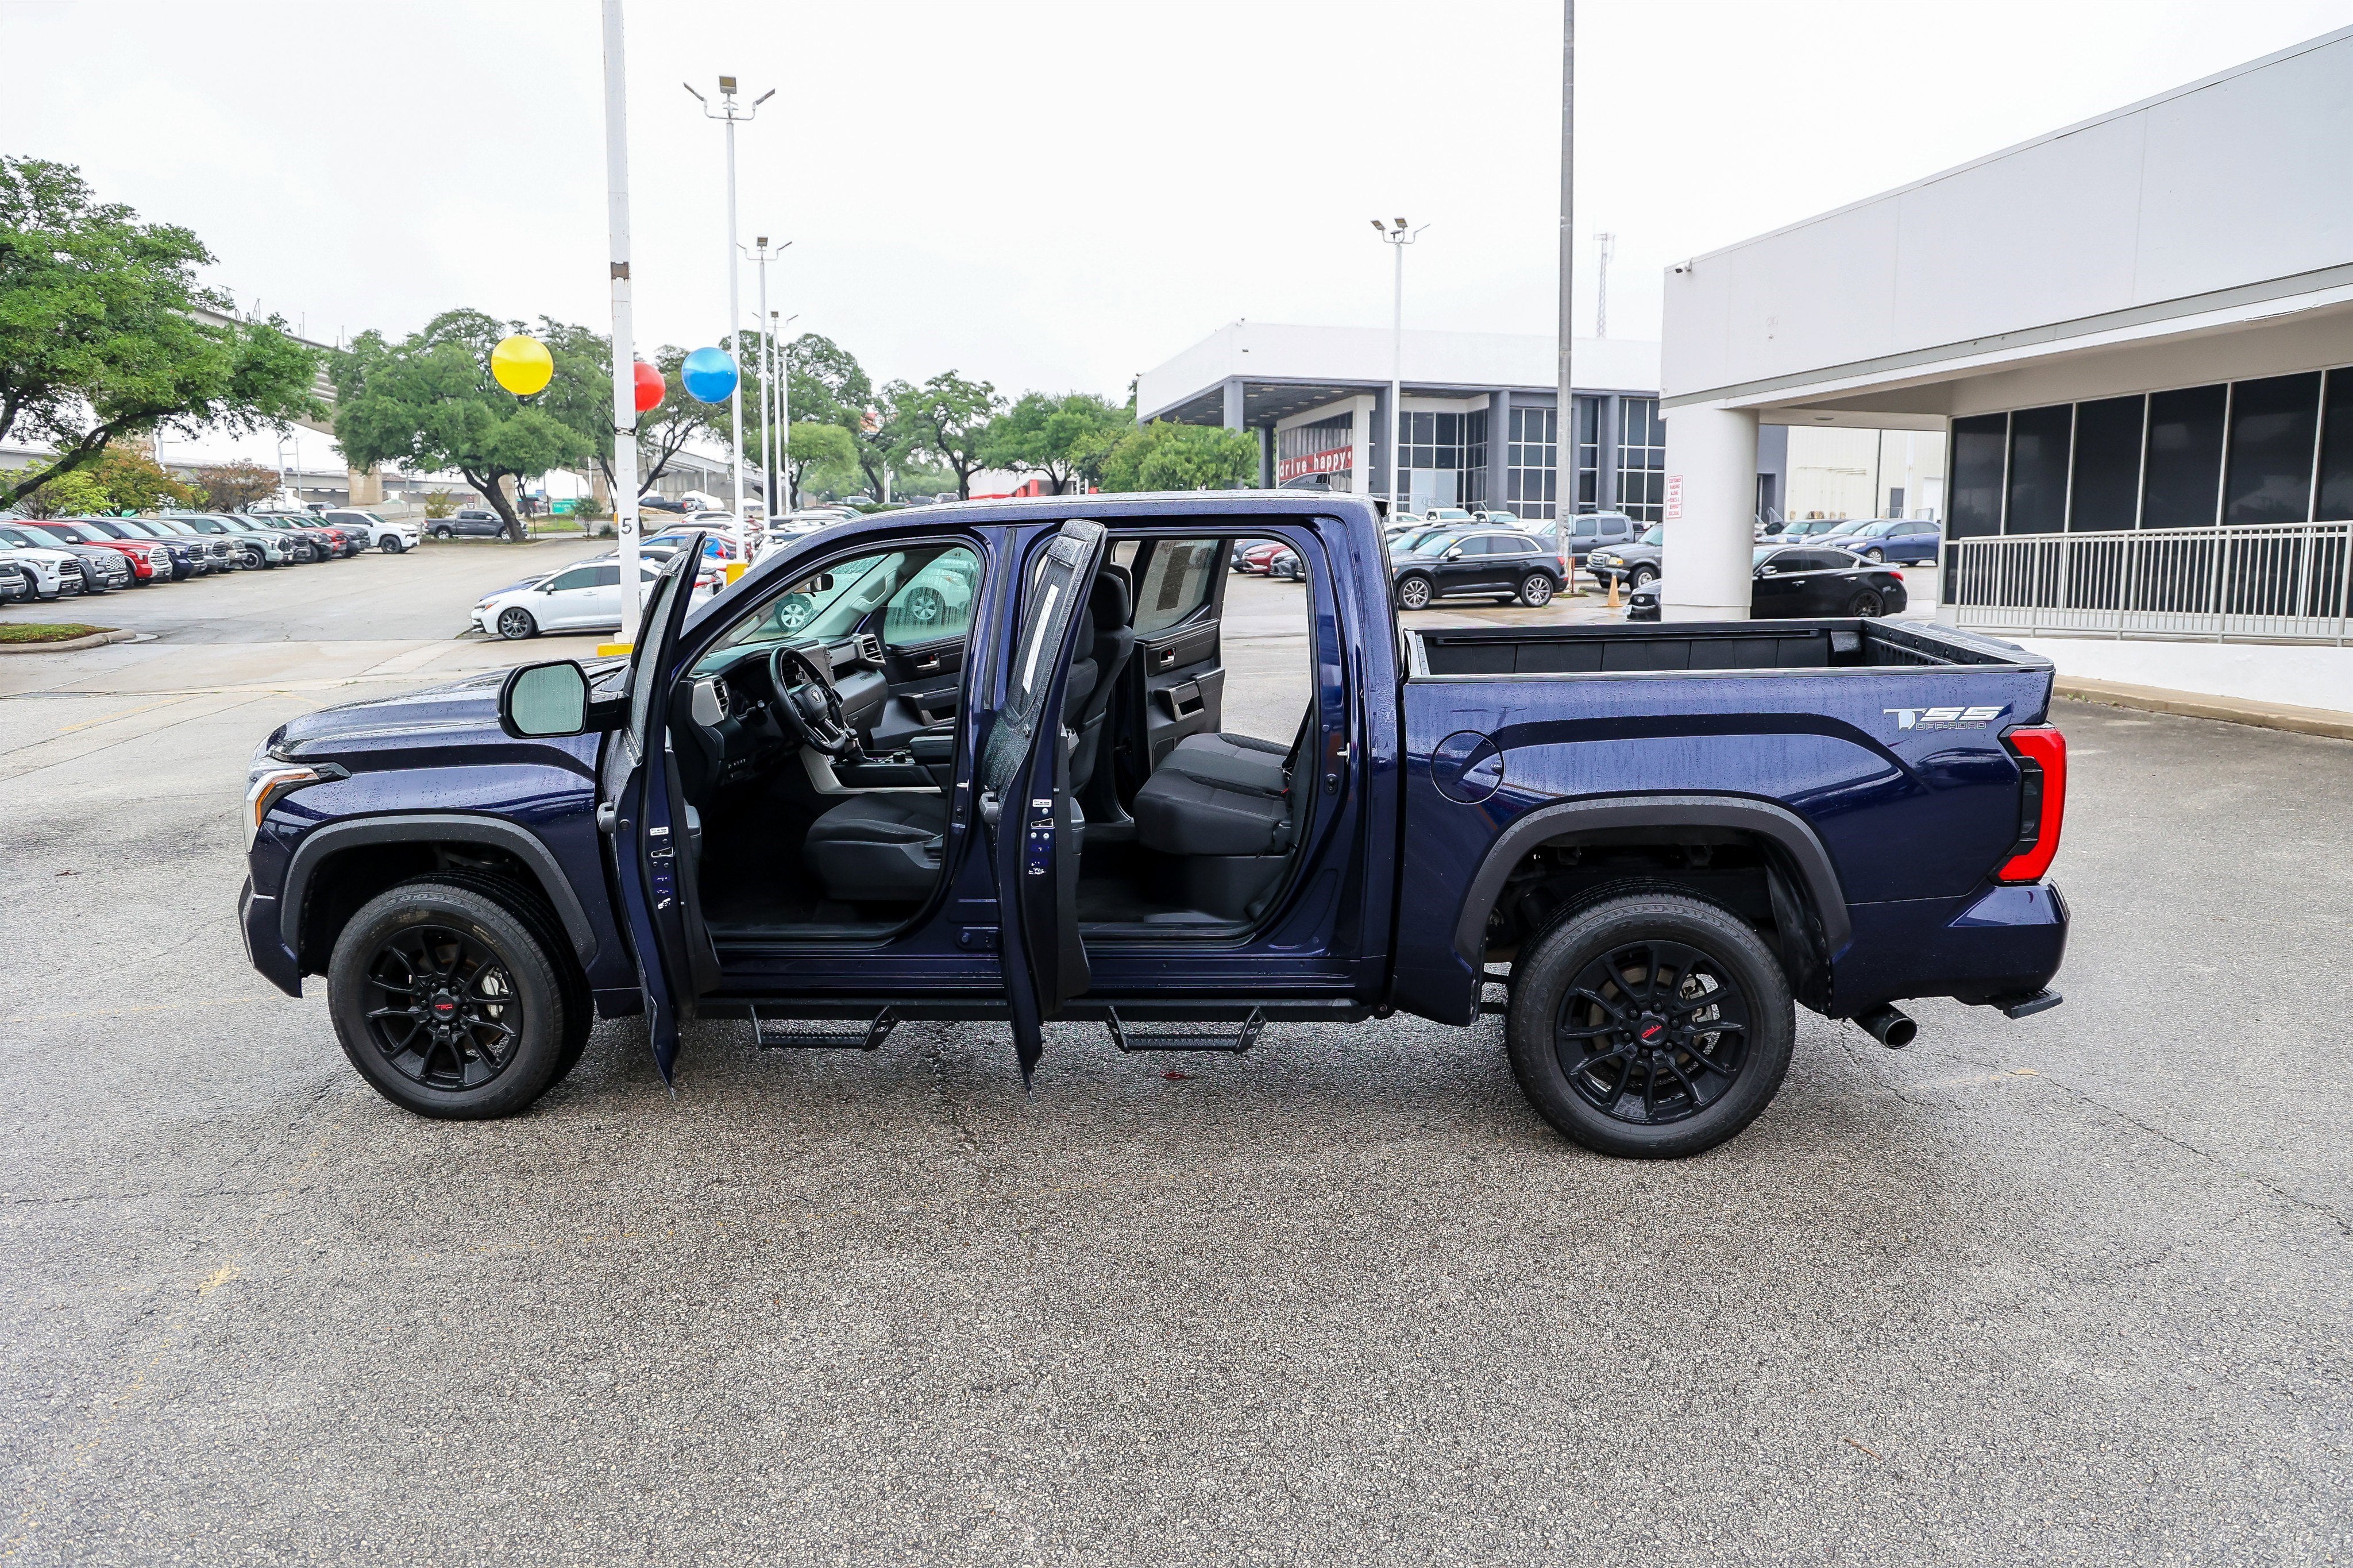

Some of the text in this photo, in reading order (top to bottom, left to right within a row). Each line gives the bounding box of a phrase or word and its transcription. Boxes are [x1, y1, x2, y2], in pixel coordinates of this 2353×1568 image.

[1280, 451, 1345, 477] drive happy
[621, 517, 632, 535] 5
[1883, 706, 2004, 729] TSS
[1916, 721, 1986, 731] OFF-ROAD
[1642, 1025, 1662, 1038] TRD
